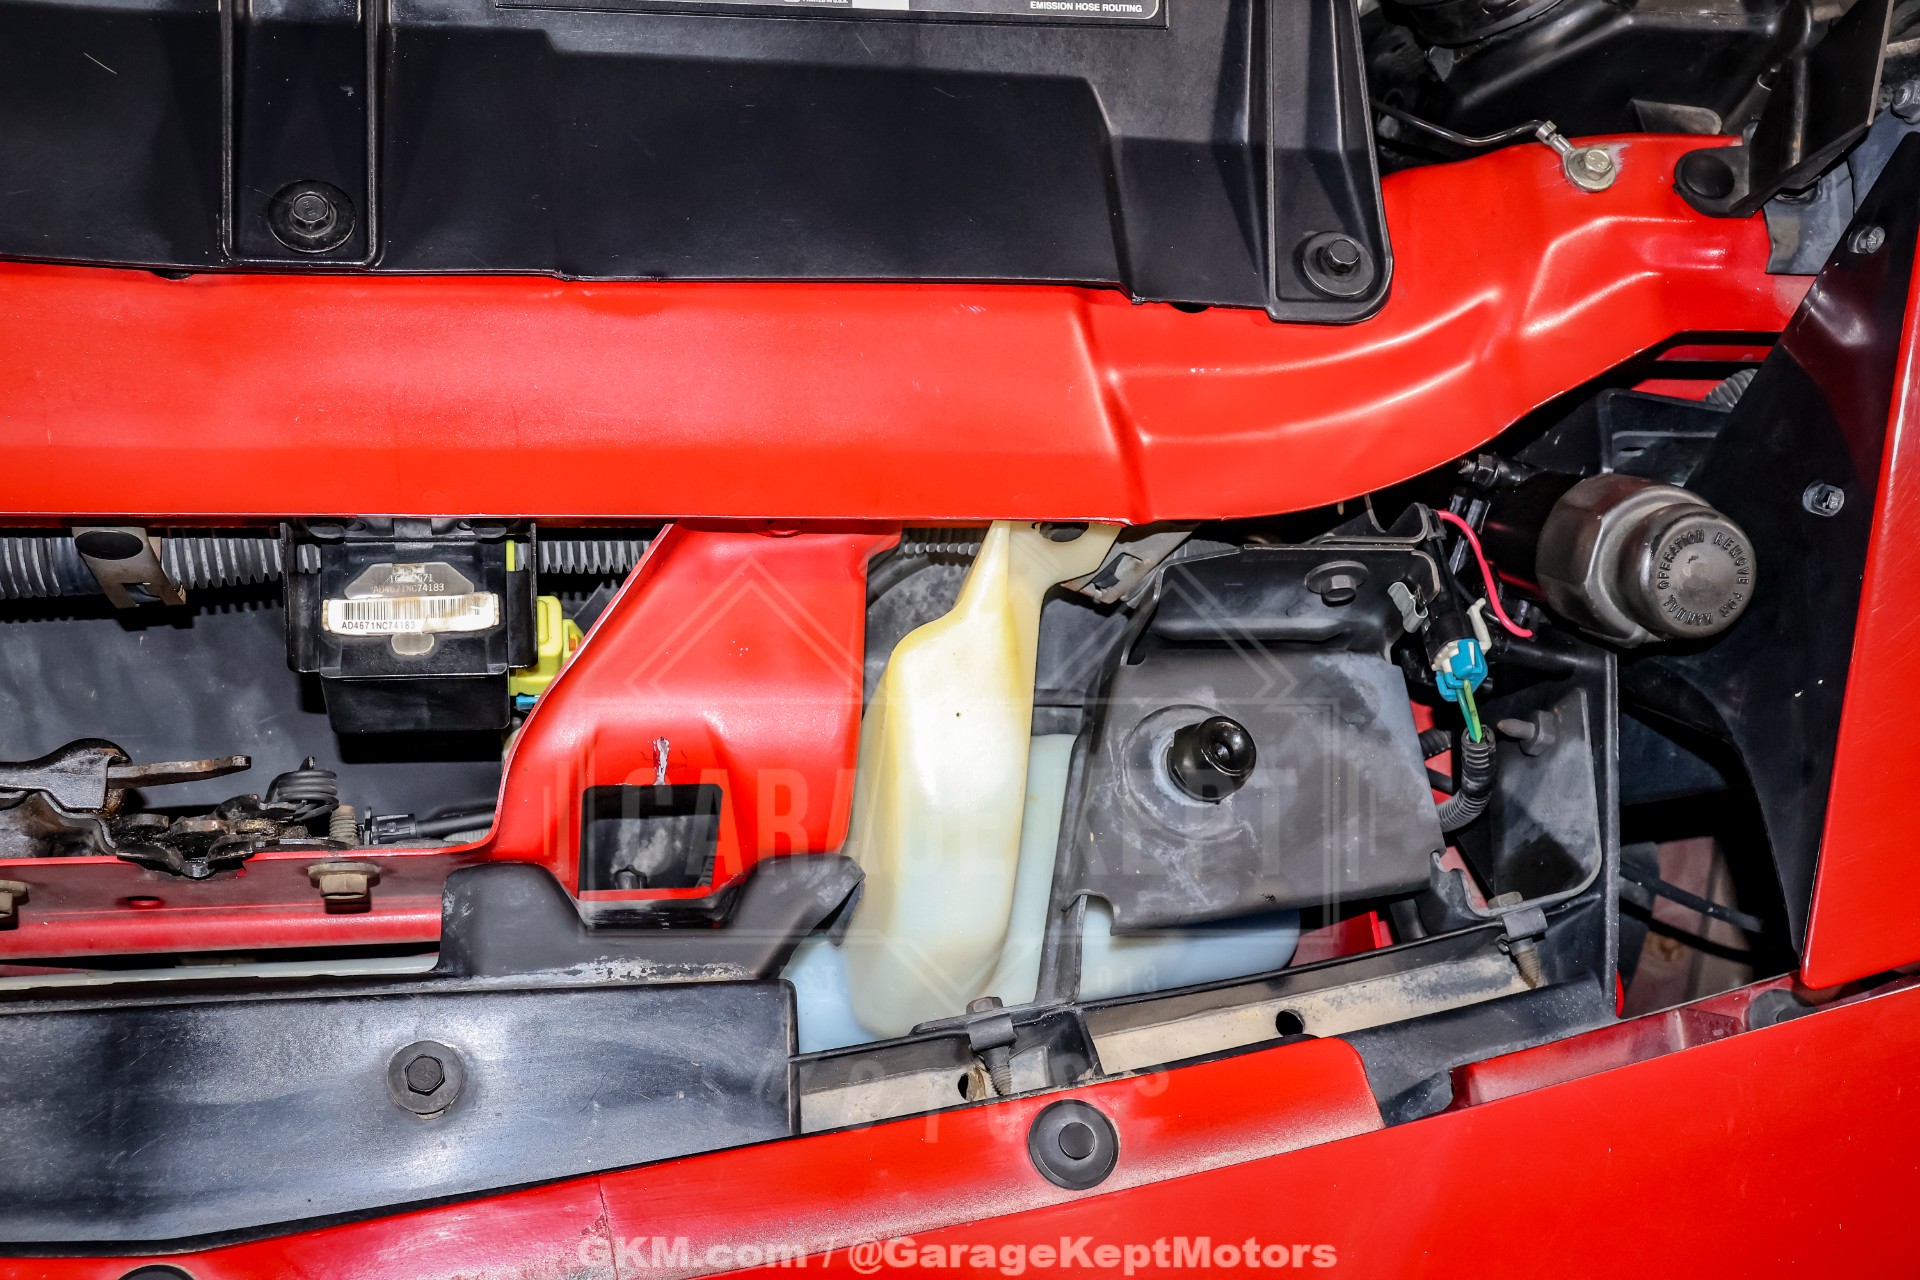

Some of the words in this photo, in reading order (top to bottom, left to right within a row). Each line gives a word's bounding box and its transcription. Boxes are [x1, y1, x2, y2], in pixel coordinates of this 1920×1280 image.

[1030, 1, 1074, 10] EMISSION
[1075, 3, 1100, 11] HOSE
[1102, 4, 1142, 13] ROUTING
[1657, 529, 1705, 590] OPERATION
[1713, 531, 1750, 585] REMOVE
[1663, 594, 1713, 626] MANUAL
[1719, 591, 1744, 618] FOR
[341, 620, 416, 630] AD4671NC74183
